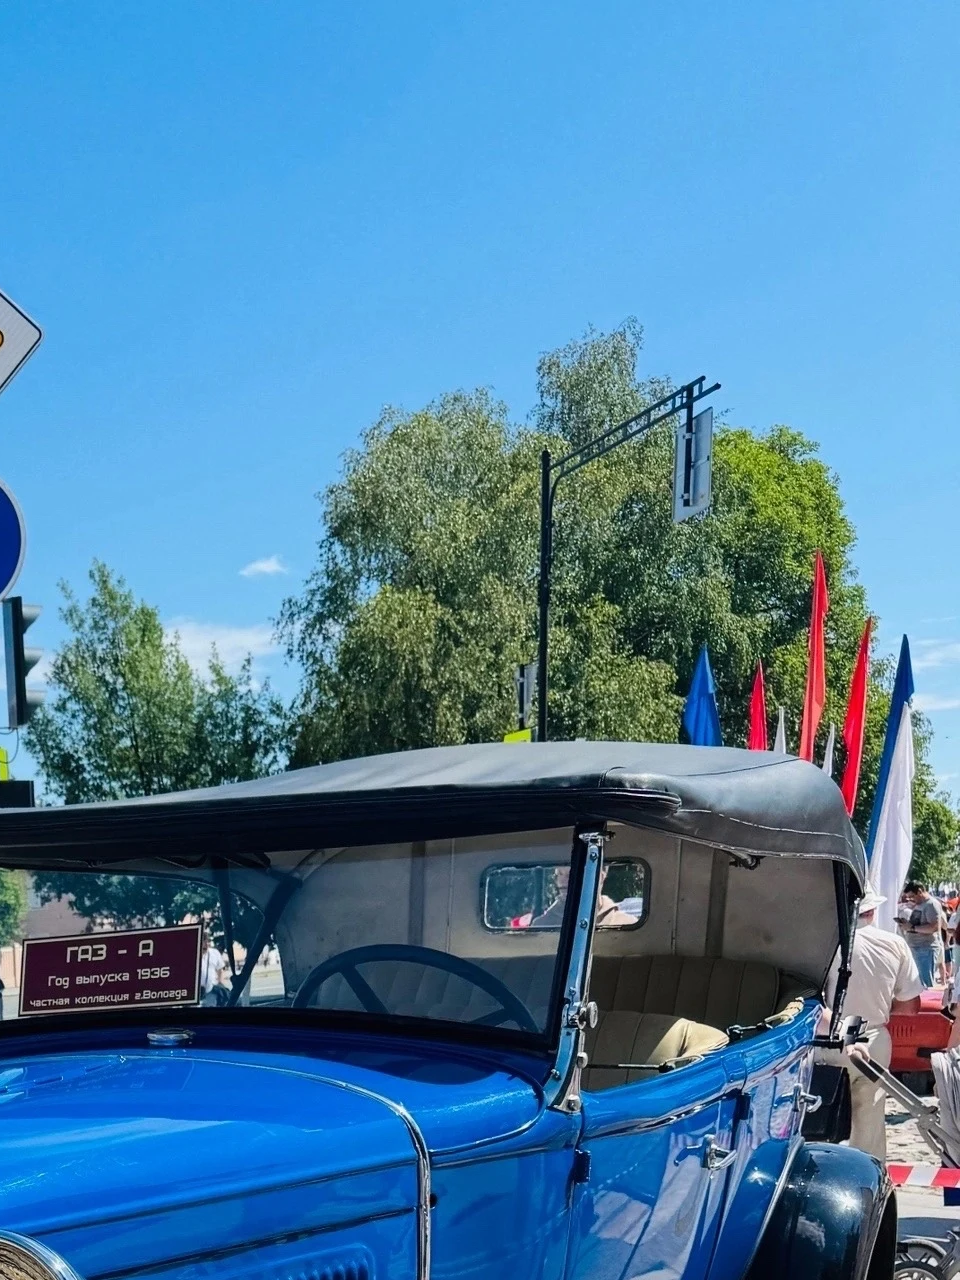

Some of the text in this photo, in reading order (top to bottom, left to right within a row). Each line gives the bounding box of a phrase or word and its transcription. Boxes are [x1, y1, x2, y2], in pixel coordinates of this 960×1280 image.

[66, 944, 107, 963] ГАЗ
[138, 939, 154, 957] А
[47, 966, 171, 989] Год выпуска 1936
[29, 988, 188, 1008] частная коллекция г.Вологда
